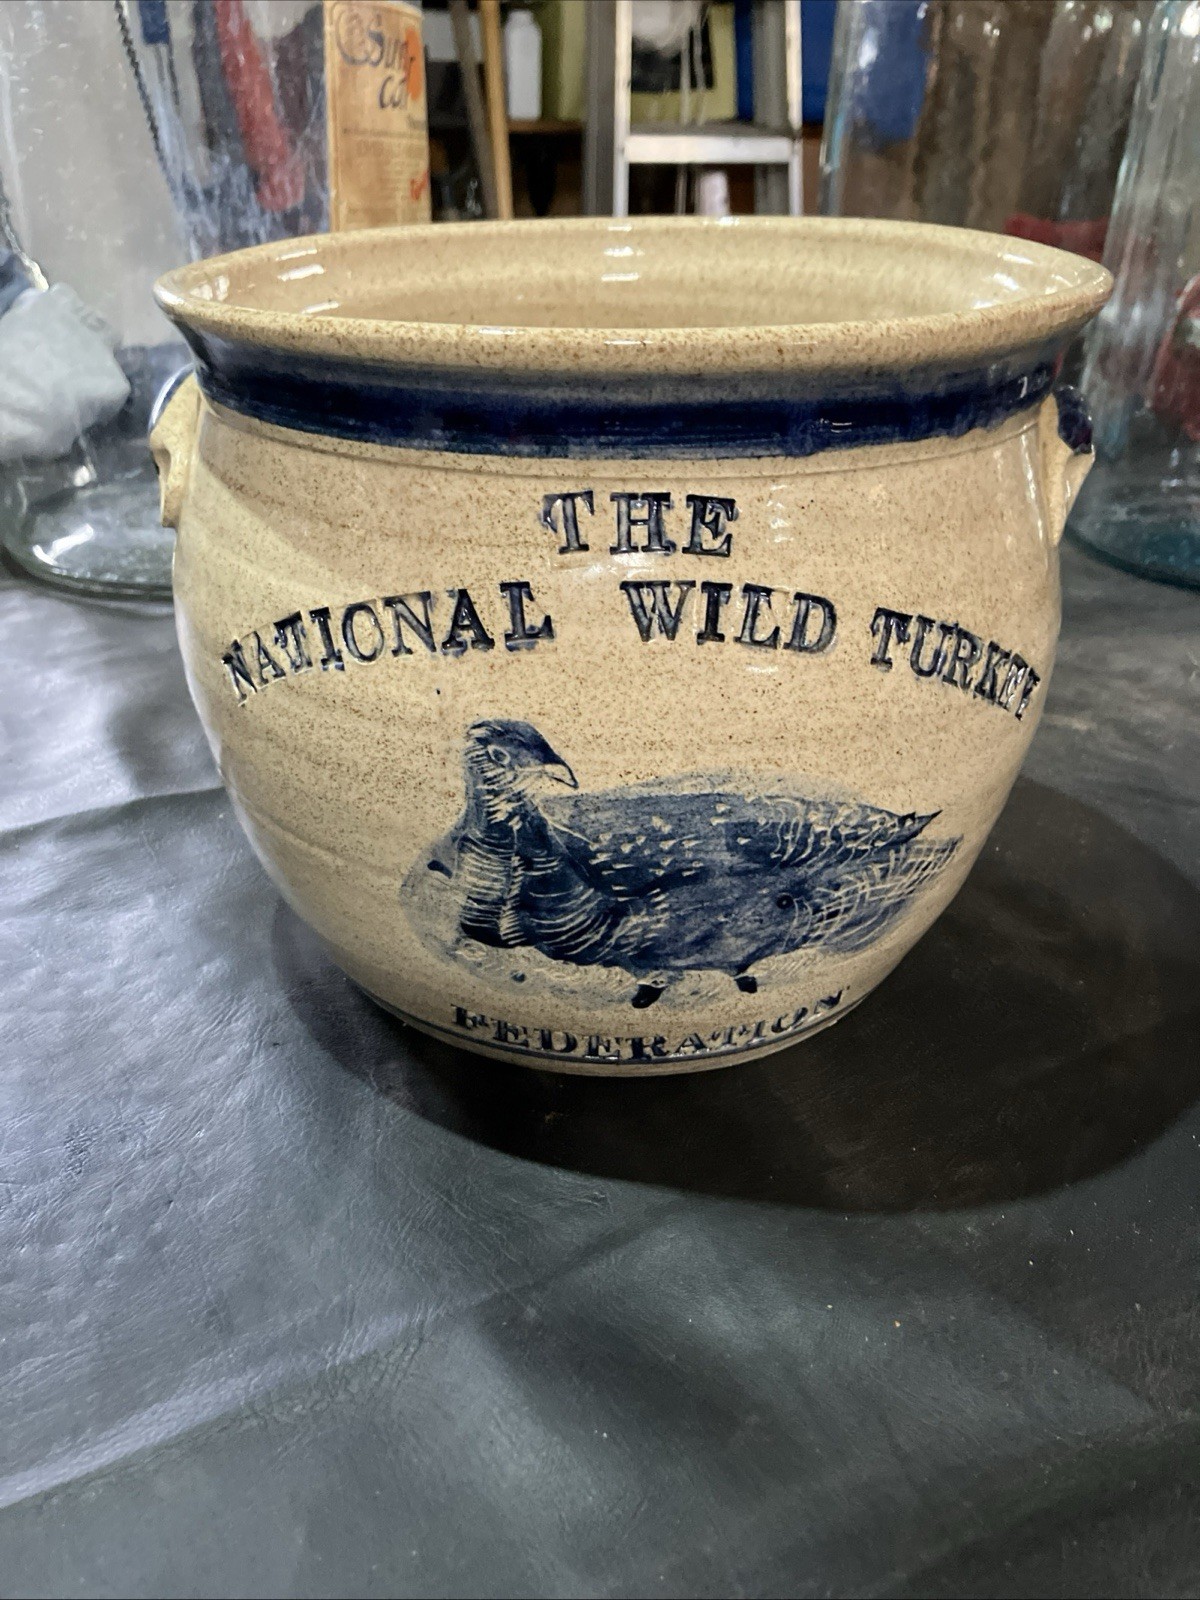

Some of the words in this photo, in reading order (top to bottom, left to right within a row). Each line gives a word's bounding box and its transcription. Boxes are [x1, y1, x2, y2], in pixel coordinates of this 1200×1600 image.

[540, 490, 738, 558] THE
[221, 580, 555, 707] NATIONAL
[619, 579, 838, 655] WILD
[870, 606, 1041, 721] TURKEY
[450, 986, 851, 1063] FEDERATION
